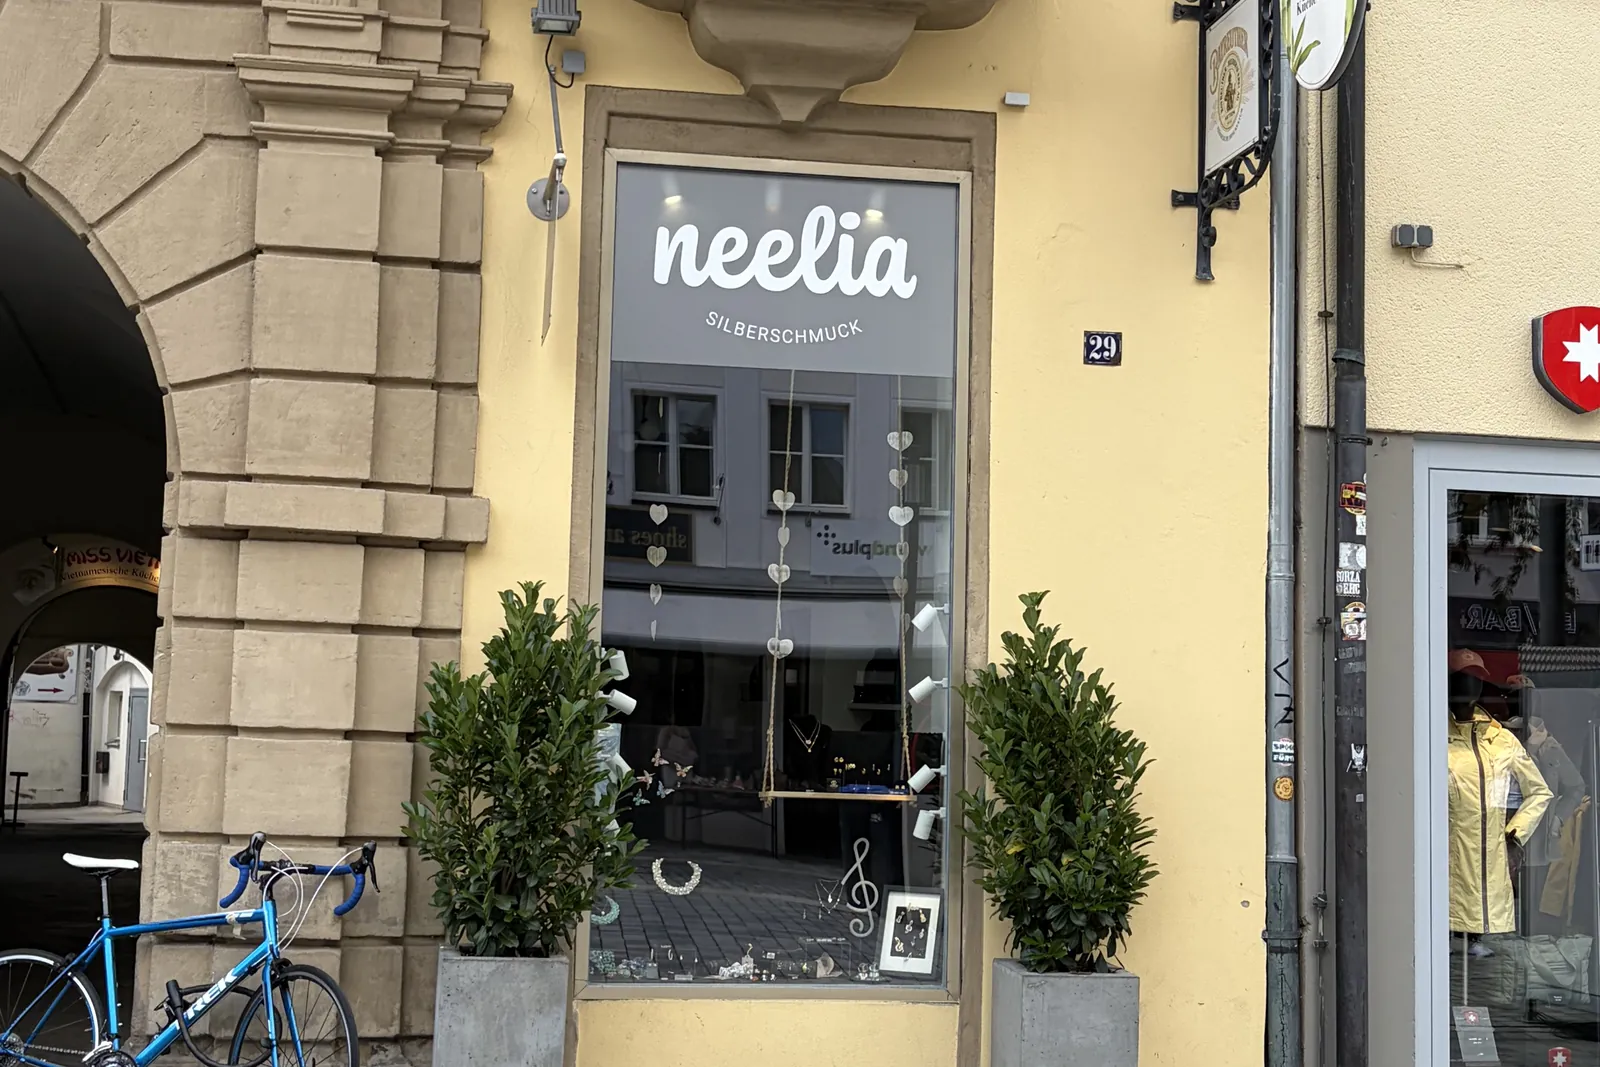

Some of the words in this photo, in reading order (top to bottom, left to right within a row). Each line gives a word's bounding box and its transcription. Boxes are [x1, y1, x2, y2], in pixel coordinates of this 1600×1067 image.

[653, 205, 918, 299] neelia
[706, 311, 863, 344] SILBERSCHMUCK
[1089, 335, 1117, 360] 29
[67, 547, 112, 567] MISS
